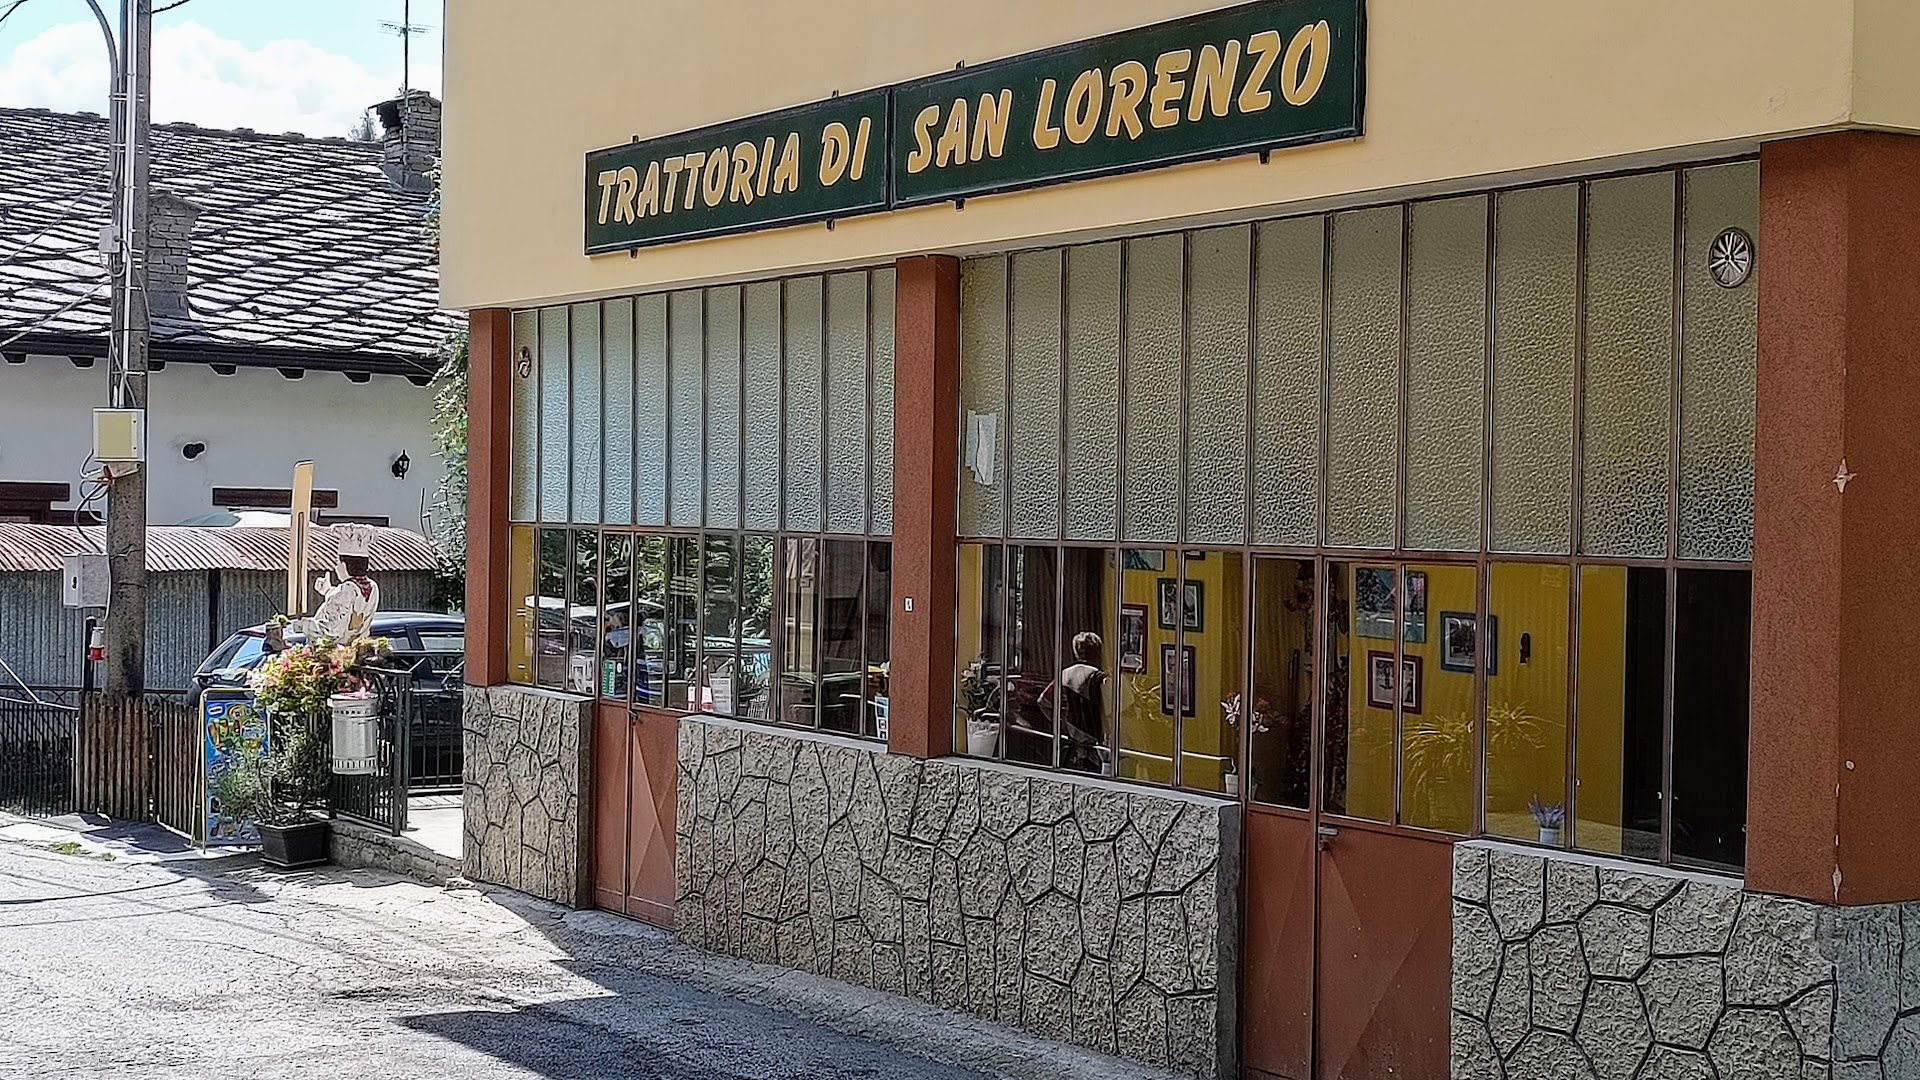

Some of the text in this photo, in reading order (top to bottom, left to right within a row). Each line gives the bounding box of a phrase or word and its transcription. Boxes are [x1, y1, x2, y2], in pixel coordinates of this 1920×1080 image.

[597, 20, 1331, 225] TRATTORIA DI SAN LORENZO
